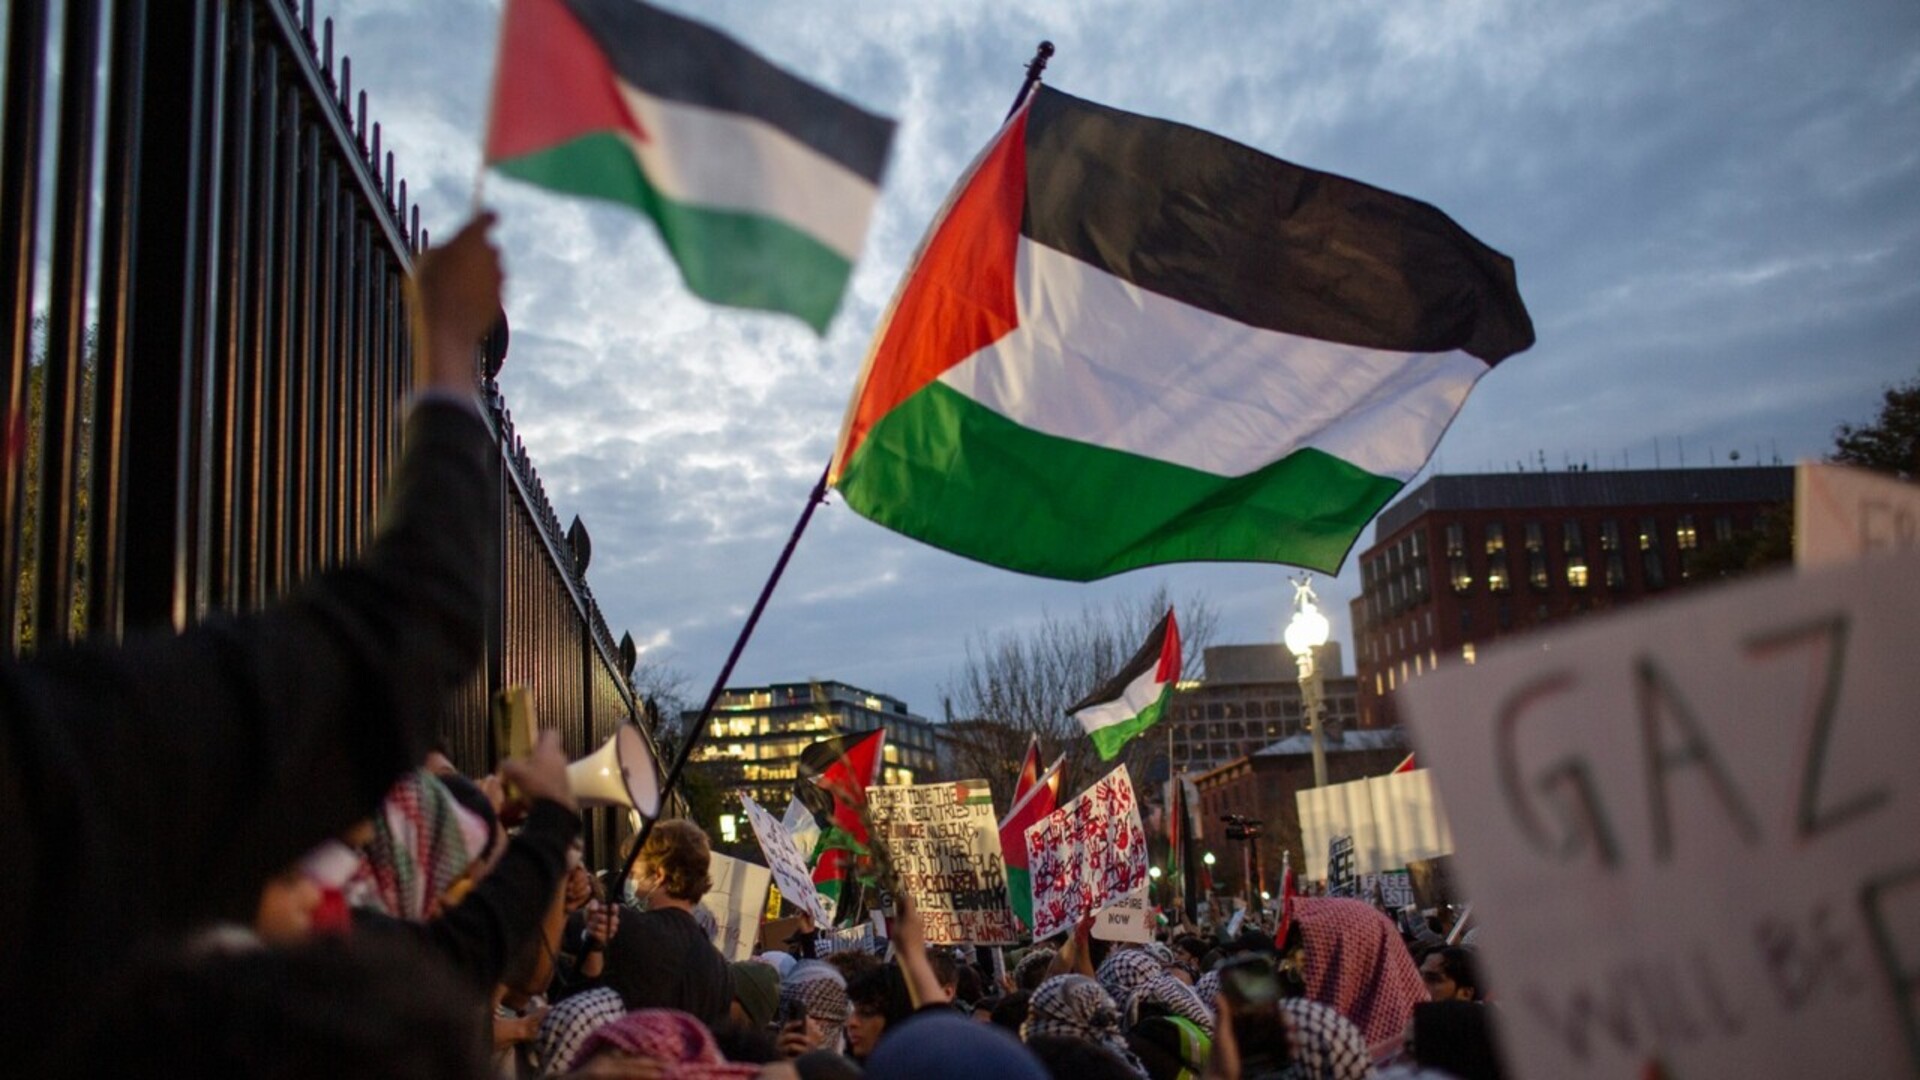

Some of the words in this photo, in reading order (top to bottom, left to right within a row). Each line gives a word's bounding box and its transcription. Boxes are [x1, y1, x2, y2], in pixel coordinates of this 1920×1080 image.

[936, 803, 969, 820] TRIES
[974, 804, 989, 817] TO
[914, 910, 953, 926] ESPECT
[1108, 912, 1130, 925] NOW
